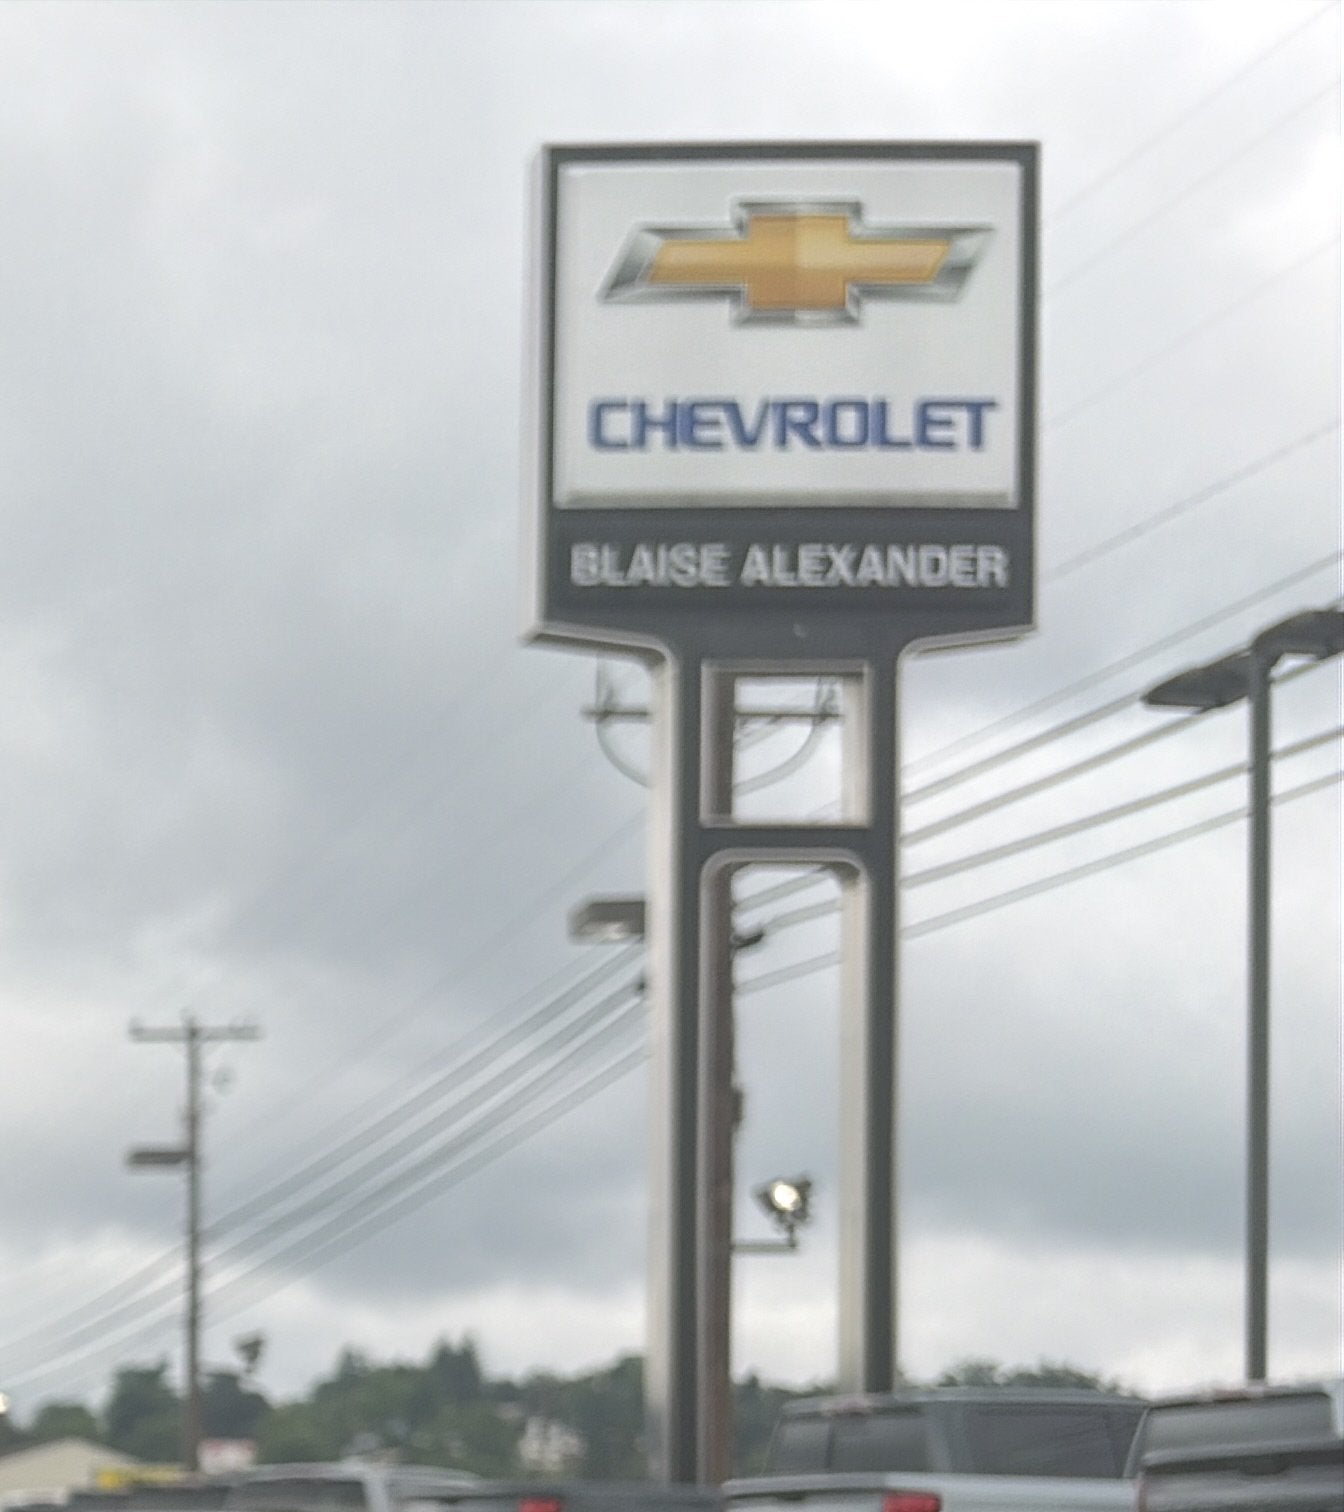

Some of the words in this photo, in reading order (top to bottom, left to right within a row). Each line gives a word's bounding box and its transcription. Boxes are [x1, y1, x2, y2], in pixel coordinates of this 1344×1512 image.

[588, 398, 997, 452] CHEVROLET
[569, 543, 730, 588] BLAISE
[740, 543, 1009, 588] ALEXANDER
